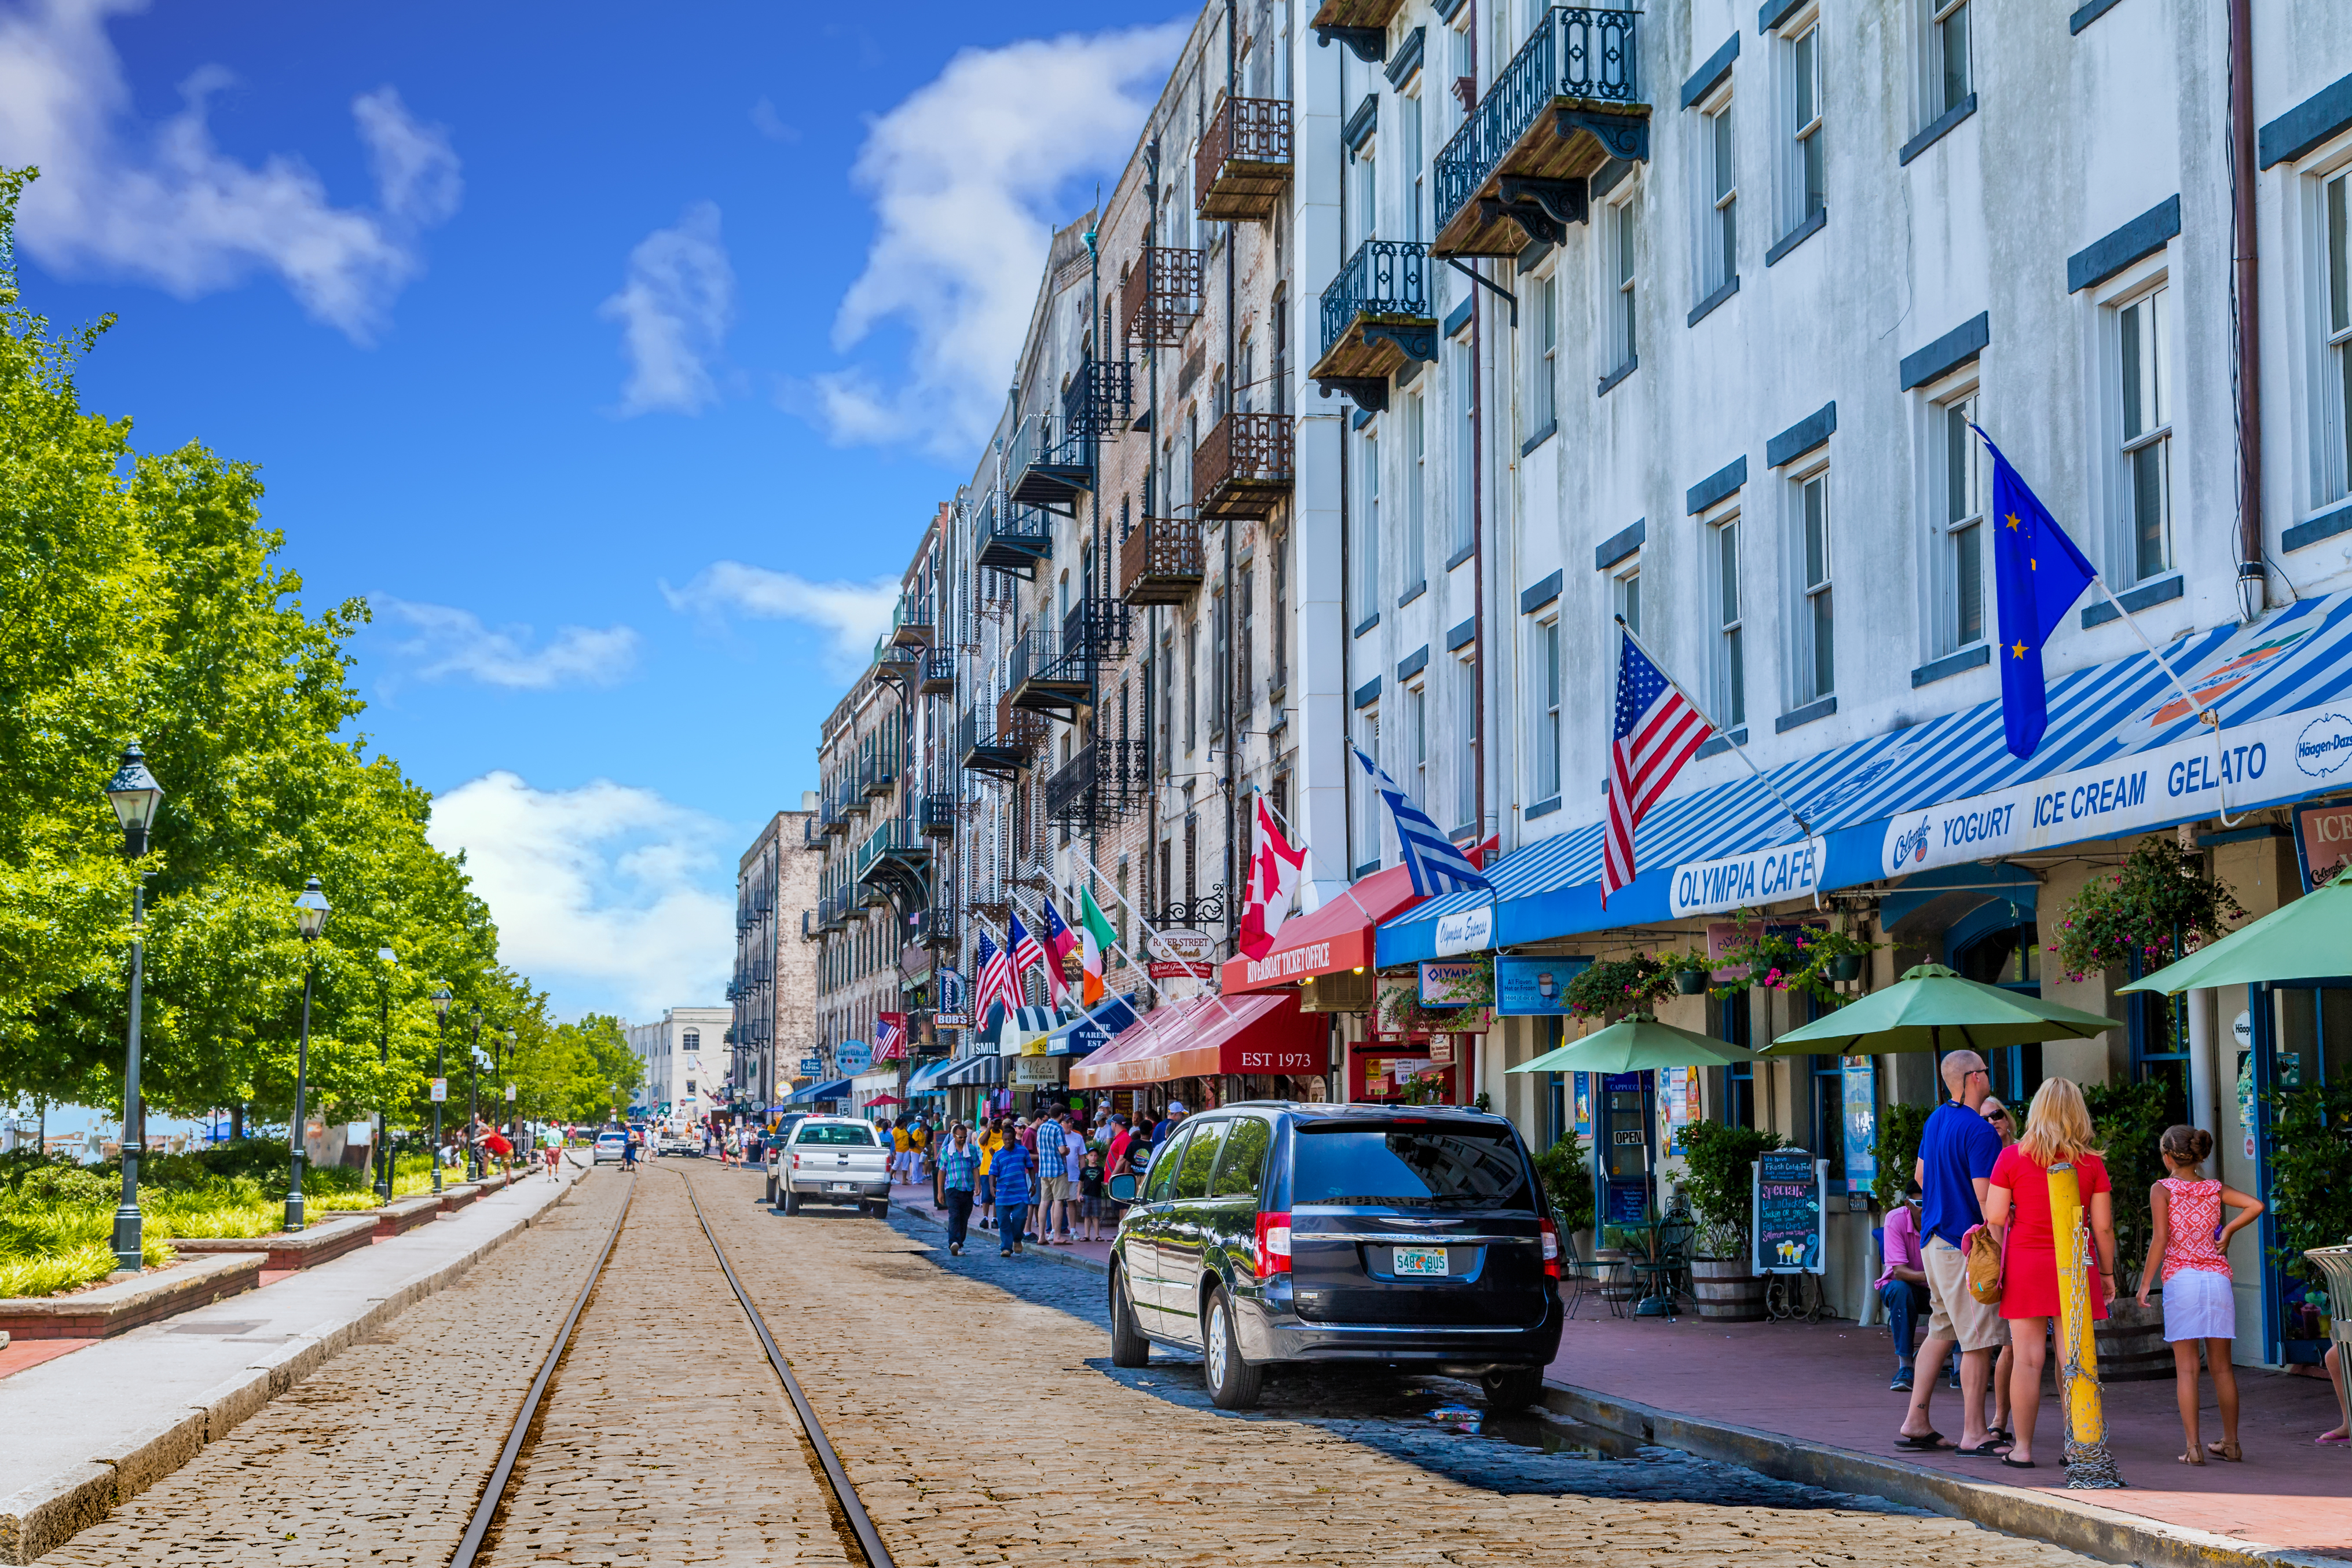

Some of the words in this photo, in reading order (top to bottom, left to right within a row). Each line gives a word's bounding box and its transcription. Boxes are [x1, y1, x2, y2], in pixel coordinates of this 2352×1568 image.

[2168, 742, 2266, 797] GELATO
[2032, 790, 2067, 829] ICE
[2071, 771, 2148, 819] CREAM
[1944, 803, 2015, 847] YOGURT
[1893, 815, 1931, 870] Colombo
[1679, 860, 1754, 908] OLYMPIA
[1761, 847, 1816, 896] CAFE
[2310, 860, 2346, 886] Colombo
[1179, 938, 1208, 946] STREET
[1440, 922, 1463, 948] Olympia
[1464, 915, 1487, 943] Express
[1247, 954, 1281, 984] RIVERBOAT
[1281, 948, 1306, 976] TICKET
[1305, 942, 1329, 970] OFFICE
[944, 977, 952, 1013] BARRACUDA
[937, 1014, 968, 1024] BOB'S
[1022, 1059, 1052, 1074] Vic's
[1156, 1056, 1170, 1079] STORE
[1241, 1053, 1273, 1066] EST
[1278, 1053, 1311, 1067] 1973
[1615, 1131, 1642, 1144] OPEN
